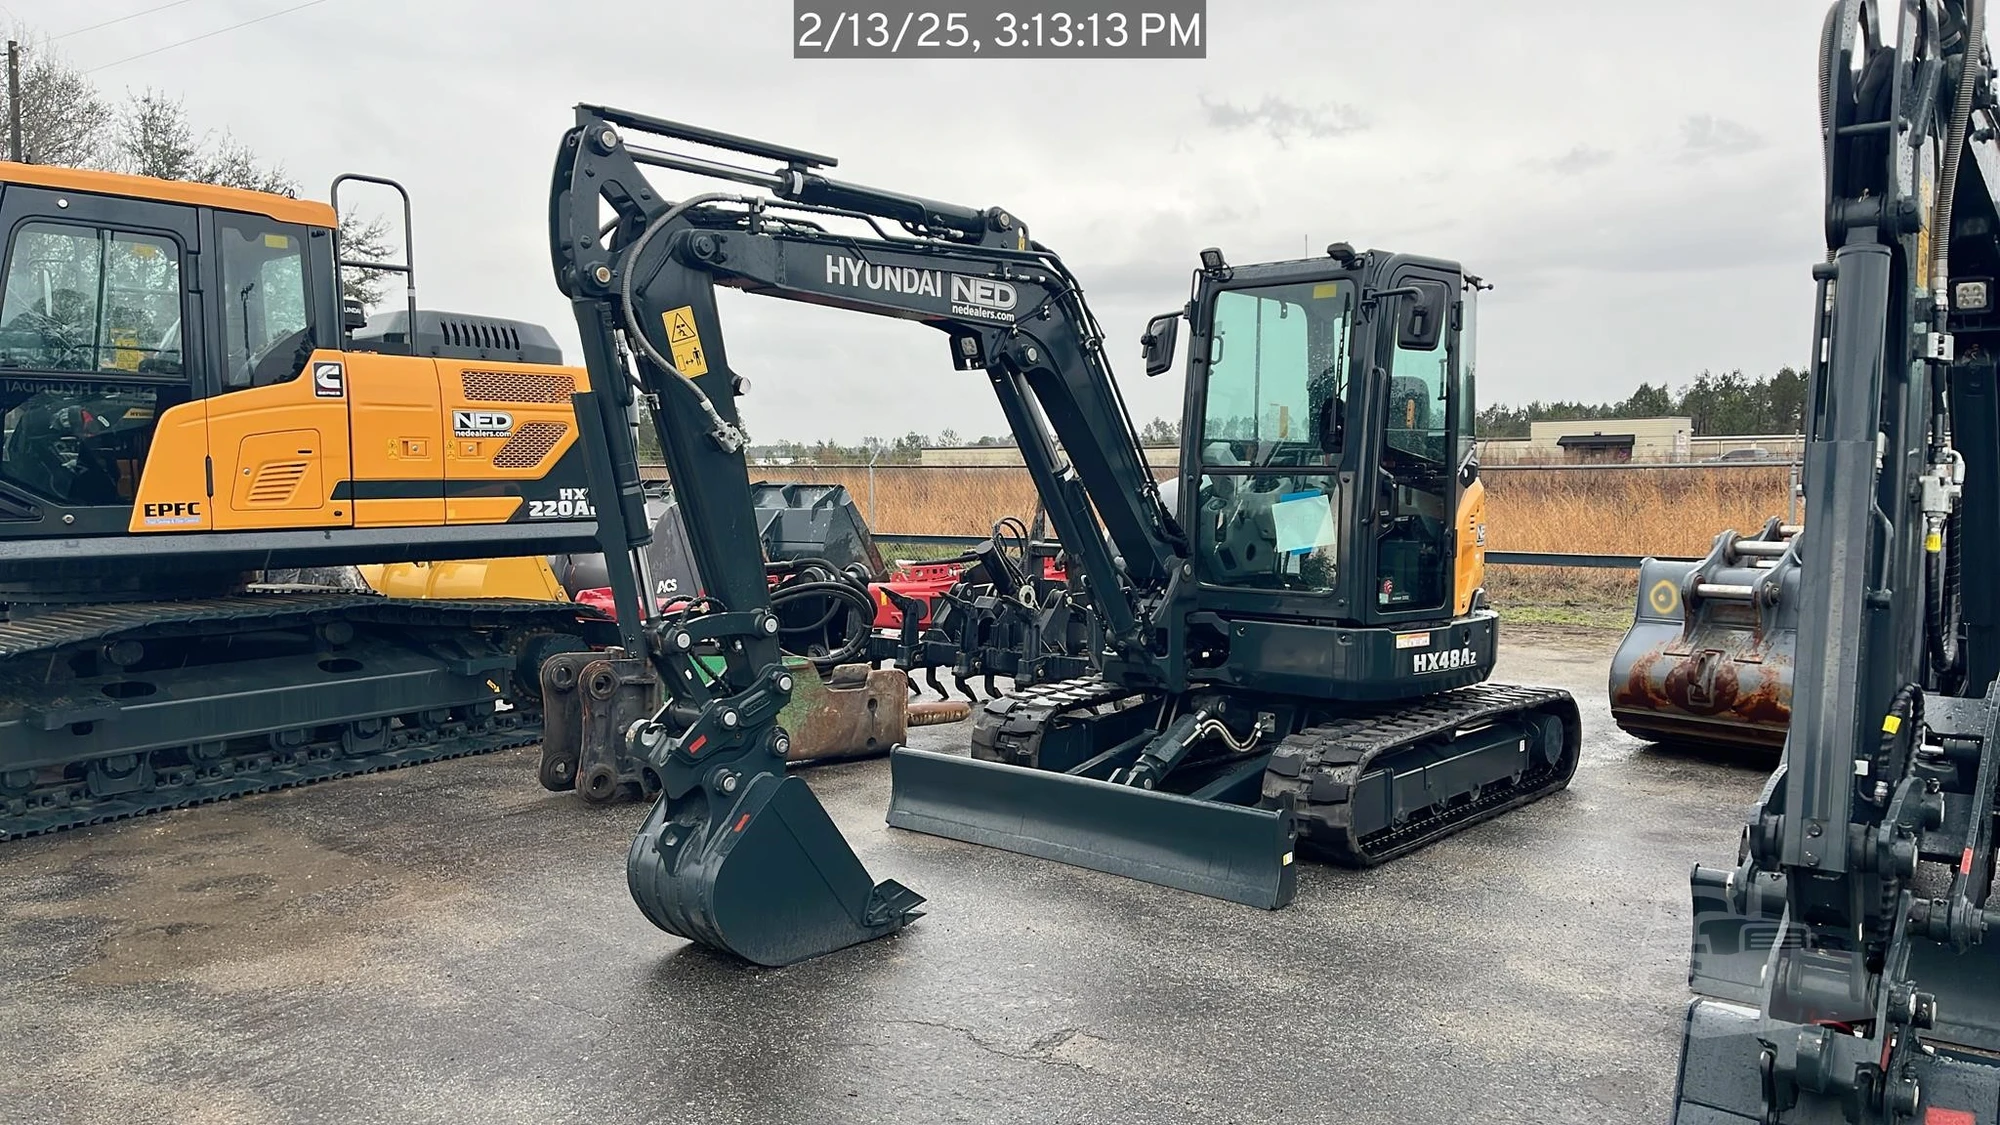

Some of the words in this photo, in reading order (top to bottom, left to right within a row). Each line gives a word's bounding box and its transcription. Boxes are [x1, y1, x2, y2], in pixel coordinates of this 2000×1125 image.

[826, 254, 943, 298] HYUNDAI
[951, 273, 1018, 311] NED
[952, 304, 1015, 322] nedealers.com
[453, 411, 514, 430] NED
[560, 488, 587, 500] HX
[144, 502, 201, 517] EPFC
[656, 578, 678, 594] ACS
